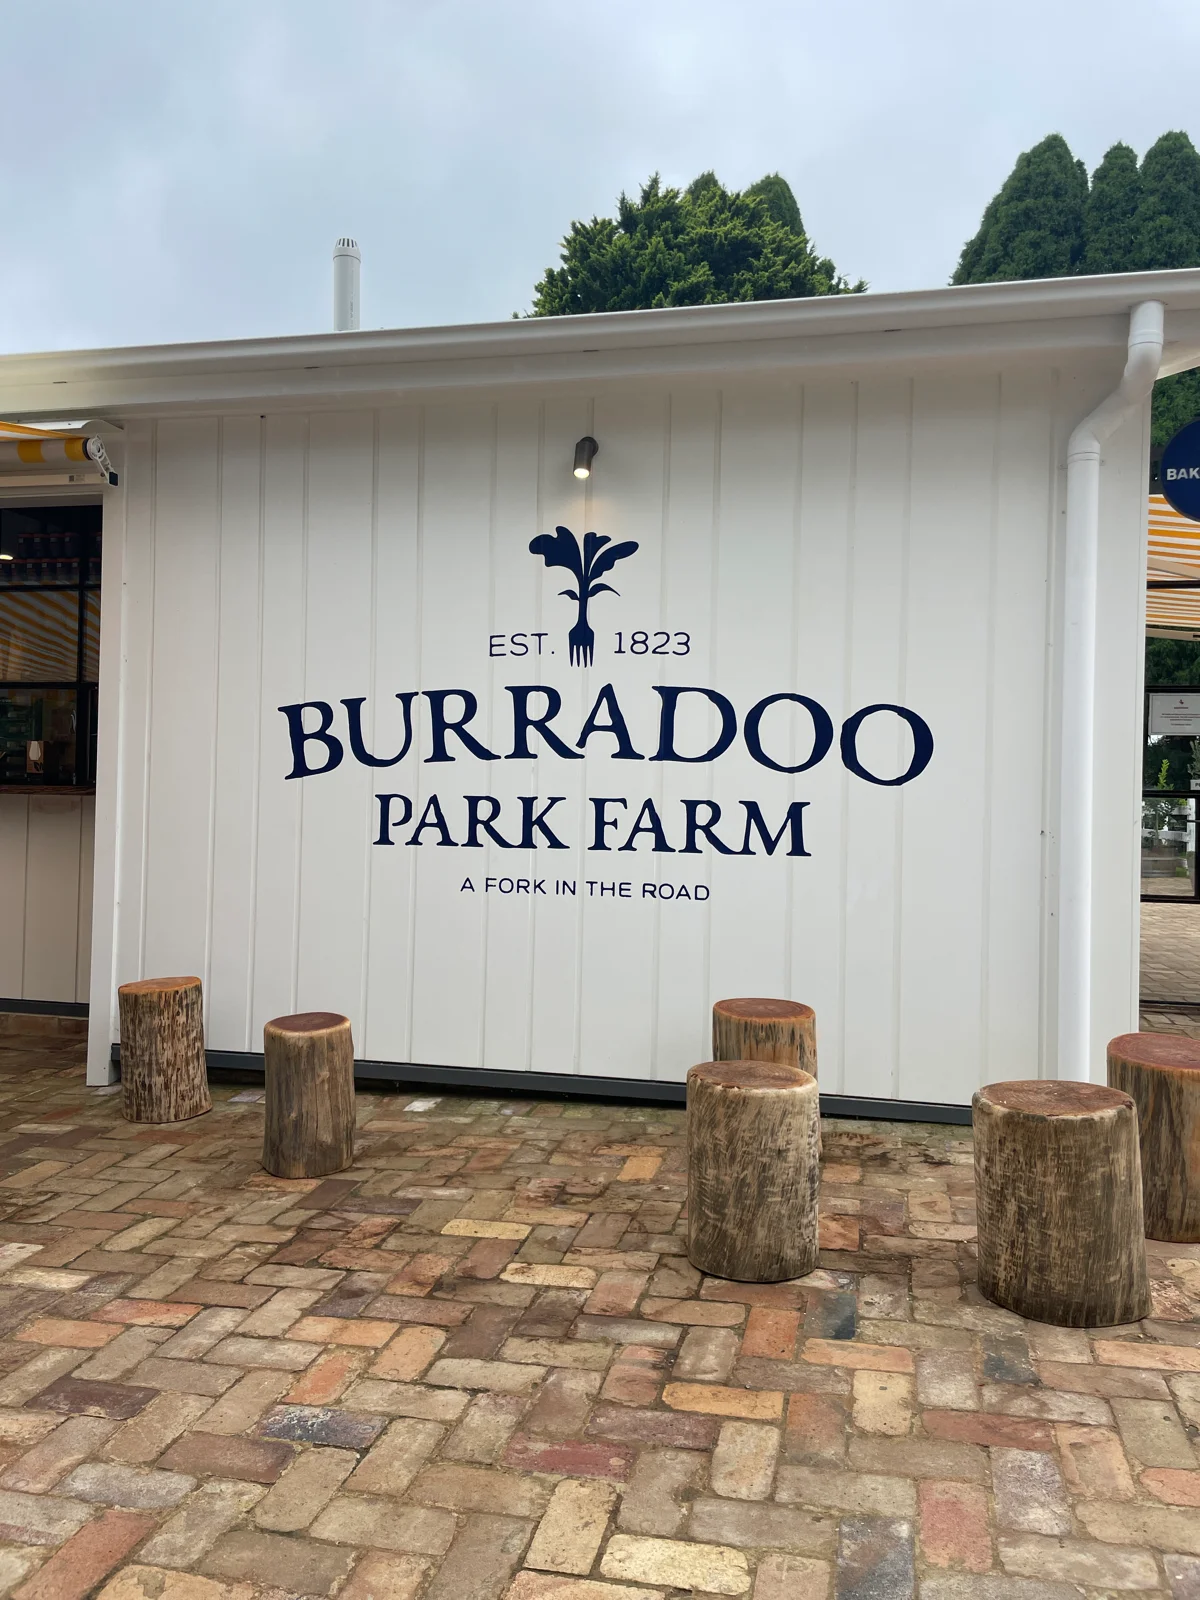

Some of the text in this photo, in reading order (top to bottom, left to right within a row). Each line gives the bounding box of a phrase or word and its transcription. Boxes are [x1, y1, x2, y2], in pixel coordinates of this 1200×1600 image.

[488, 631, 691, 658] EST. 1823
[277, 682, 936, 787] BURRADOO
[372, 793, 812, 857] PARK FARM
[460, 877, 710, 901] A FORK IN THE ROAD
